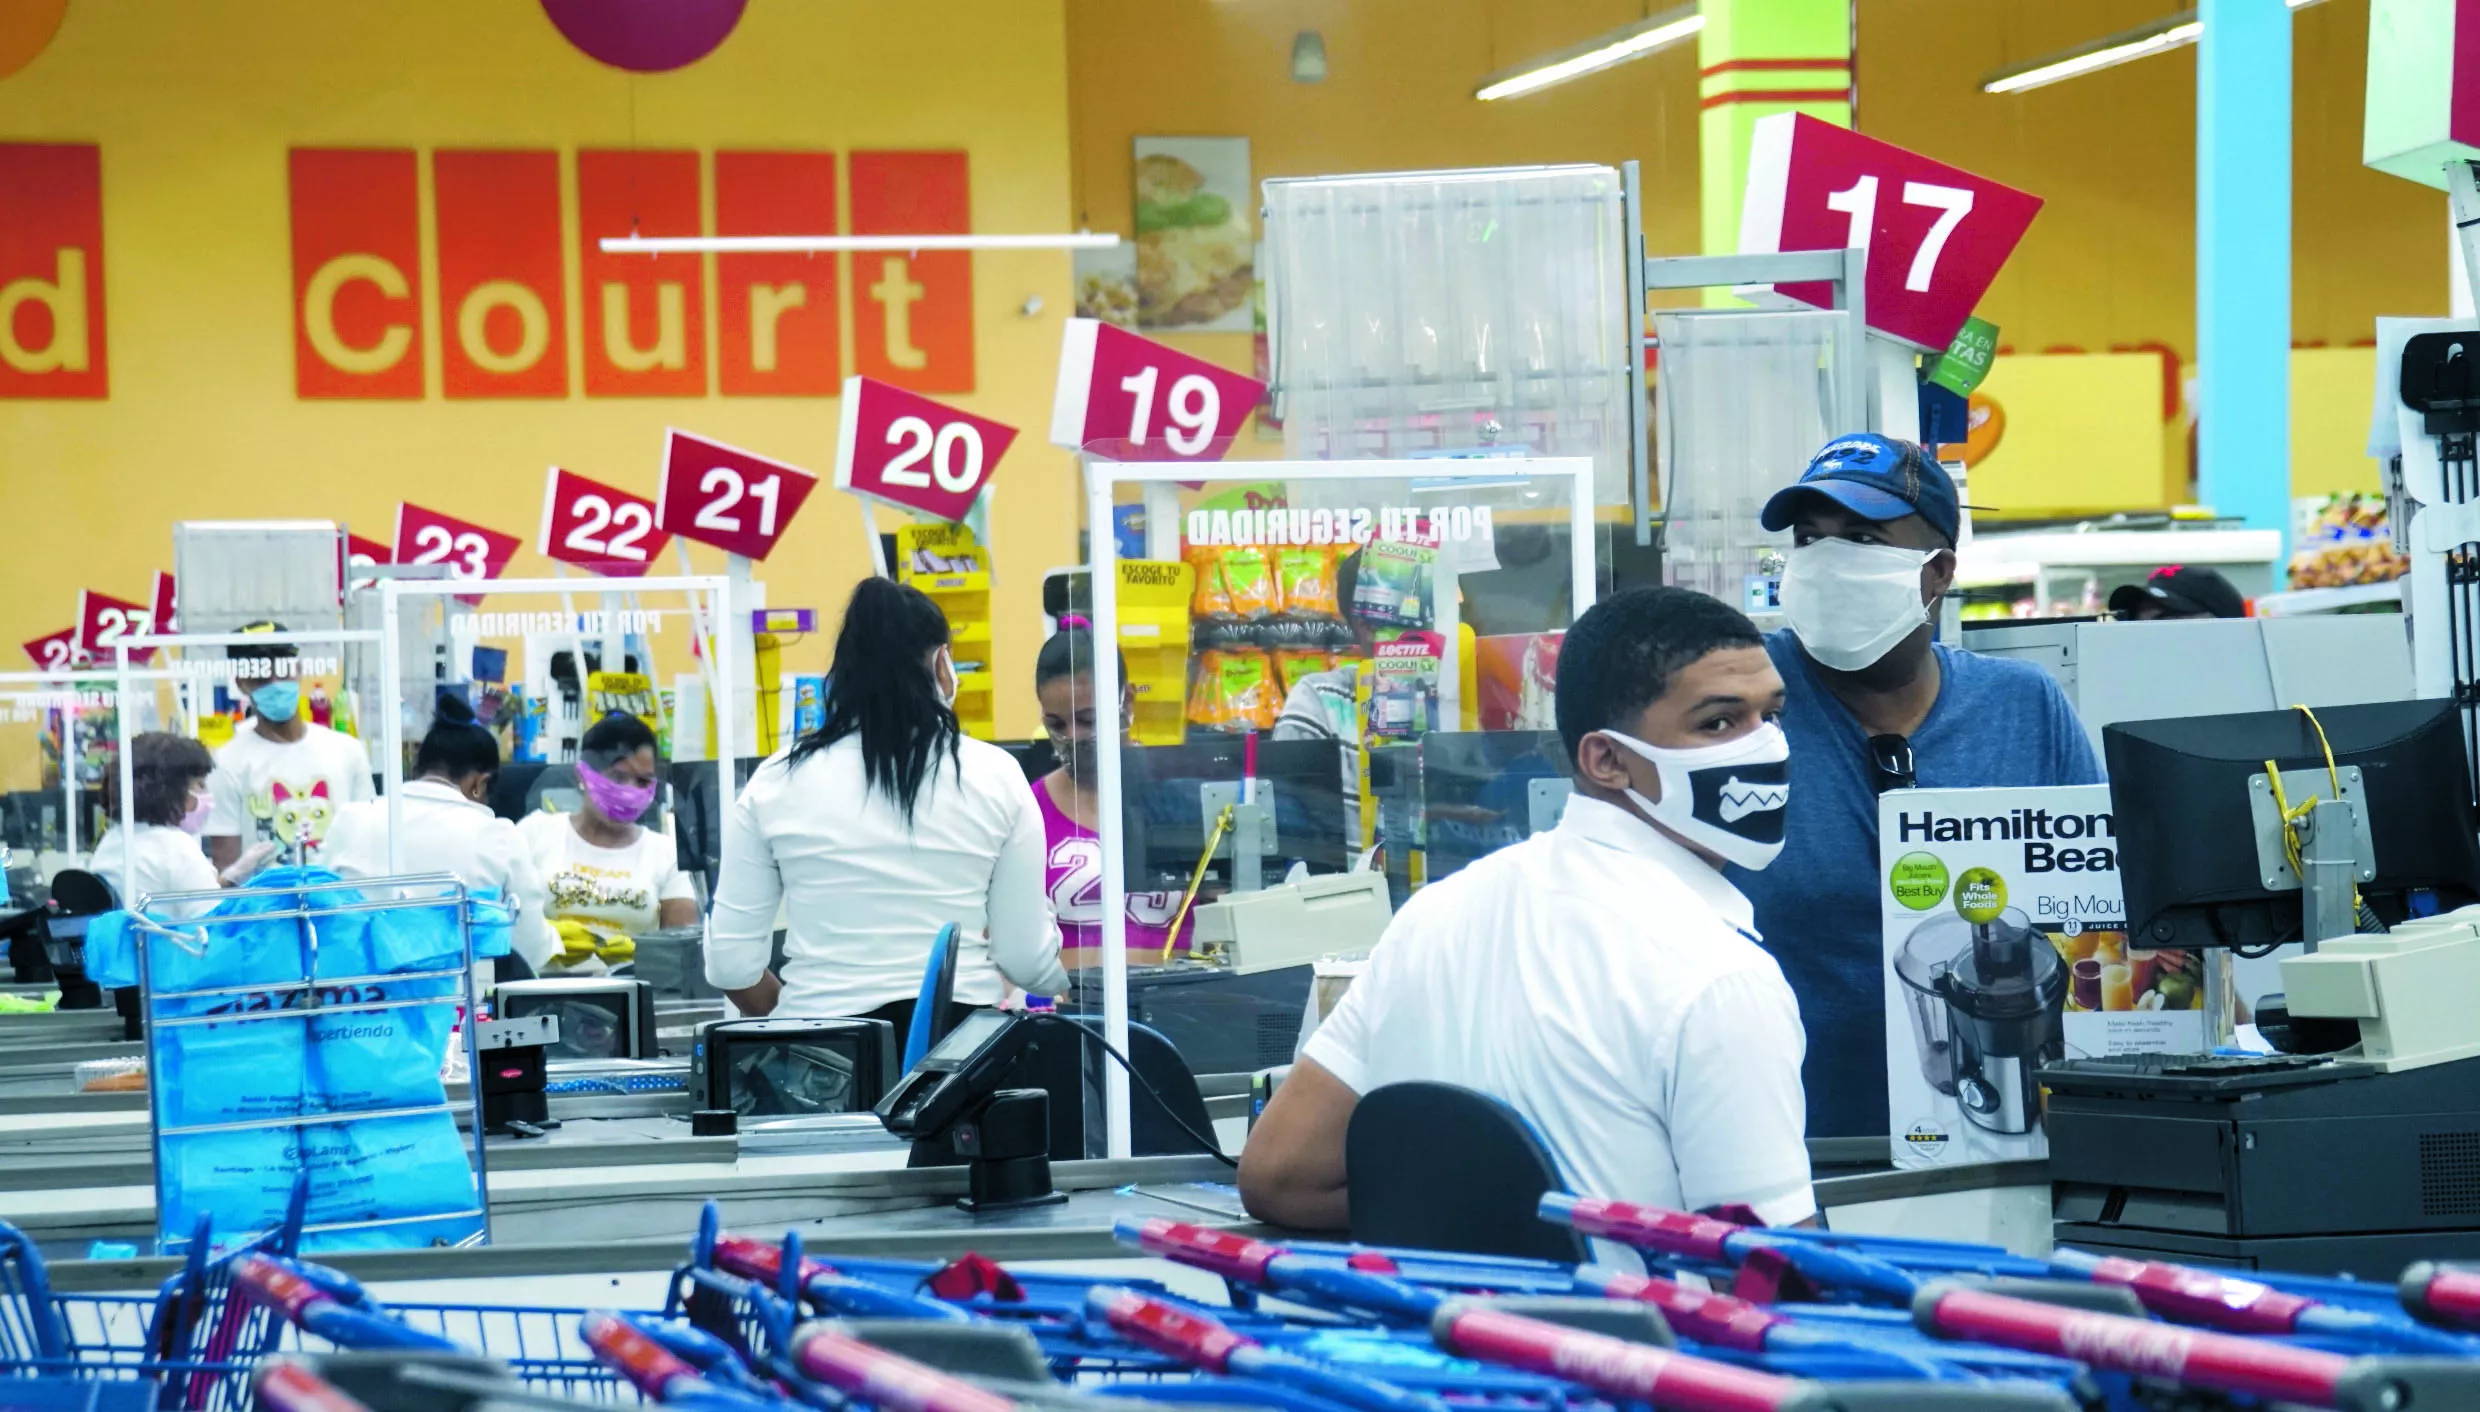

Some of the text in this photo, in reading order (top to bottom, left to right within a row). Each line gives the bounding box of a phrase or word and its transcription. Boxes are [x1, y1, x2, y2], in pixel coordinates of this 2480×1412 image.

[1827, 174, 1975, 293] 17
[303, 254, 927, 374] Court
[1120, 365, 1221, 457] 19
[880, 415, 984, 494] 20
[694, 466, 781, 537] 21
[564, 493, 653, 562] 22
[412, 524, 490, 581] 23
[1122, 564, 1181, 577] ESCOGE TU
[1126, 574, 1176, 586] FAVORITO
[95, 606, 151, 650] 27
[1377, 643, 1431, 657] LOCTITE
[1899, 808, 2116, 843] Hamilton
[2023, 842, 2121, 874] Bea
[1896, 885, 1946, 900] Best Buy
[1962, 891, 1998, 901] Whole
[1969, 882, 1991, 892] Fits
[1962, 900, 1998, 909] Foods
[2037, 894, 2125, 920] Big Mou
[2088, 922, 2119, 930] JUICE
